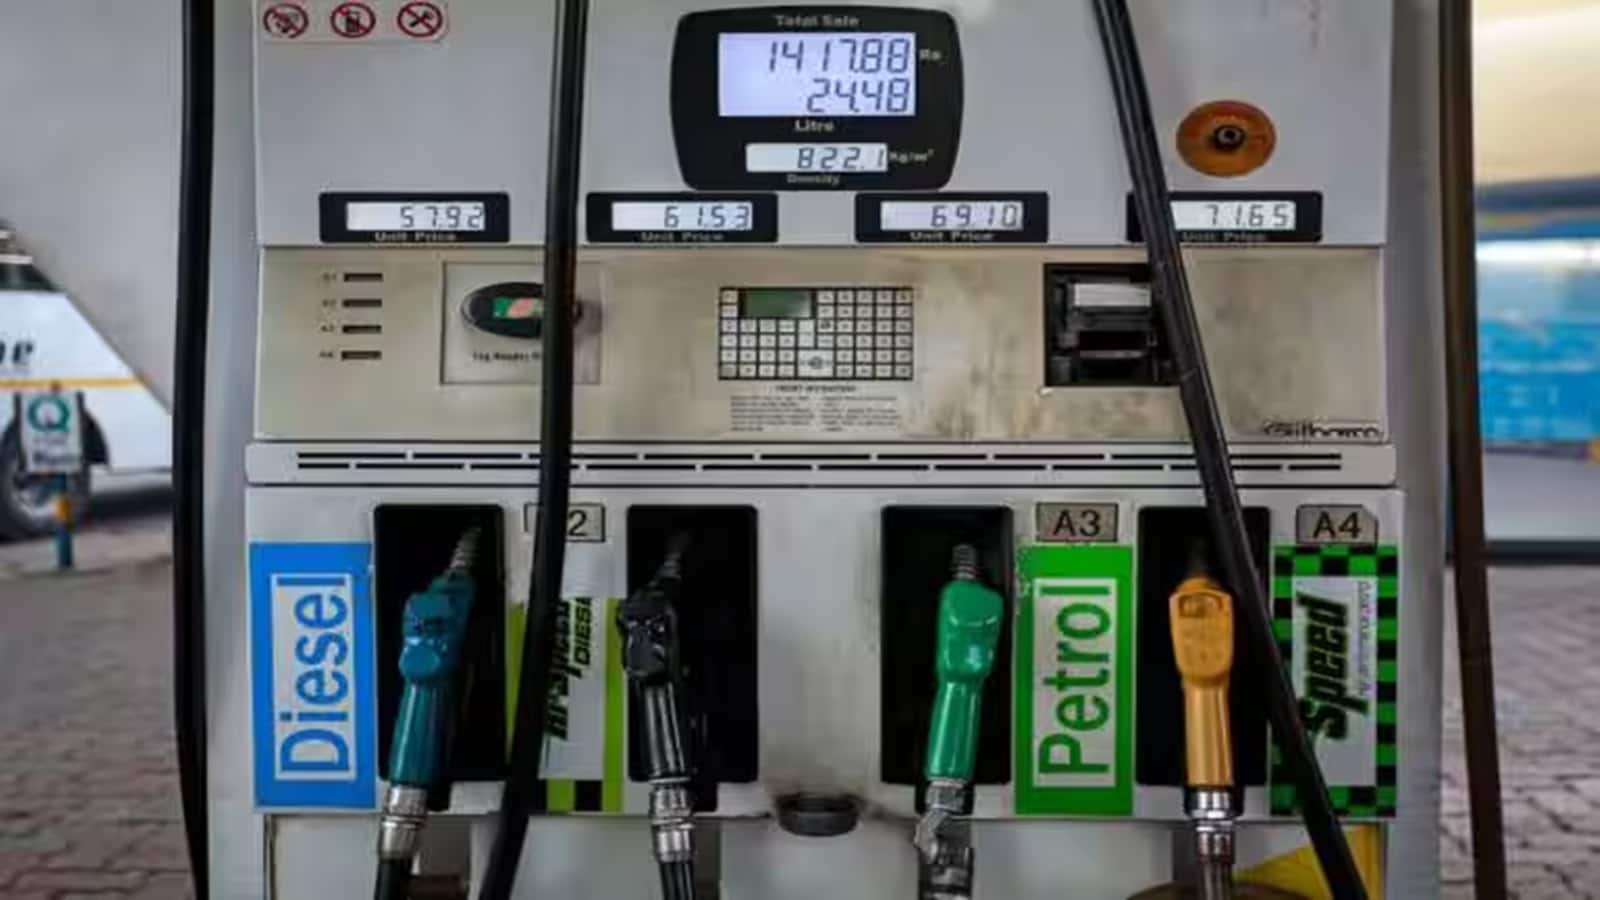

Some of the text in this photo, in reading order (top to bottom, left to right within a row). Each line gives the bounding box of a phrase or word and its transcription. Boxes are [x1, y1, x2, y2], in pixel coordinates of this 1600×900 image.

[776, 15, 859, 26] Total Sale
[769, 38, 911, 73] 1417.88
[806, 78, 910, 112] 24.48
[794, 119, 834, 132] Litre
[797, 147, 884, 169] 822.1
[375, 232, 457, 242] Unit Price
[640, 231, 674, 242] Unit
[909, 231, 995, 242] Unit Price
[567, 509, 588, 537] 2
[1053, 509, 1102, 537] A3
[1313, 511, 1362, 539] A4
[279, 575, 351, 772] Diesel
[1038, 583, 1111, 775] Petrol
[1296, 590, 1369, 741] Speed
